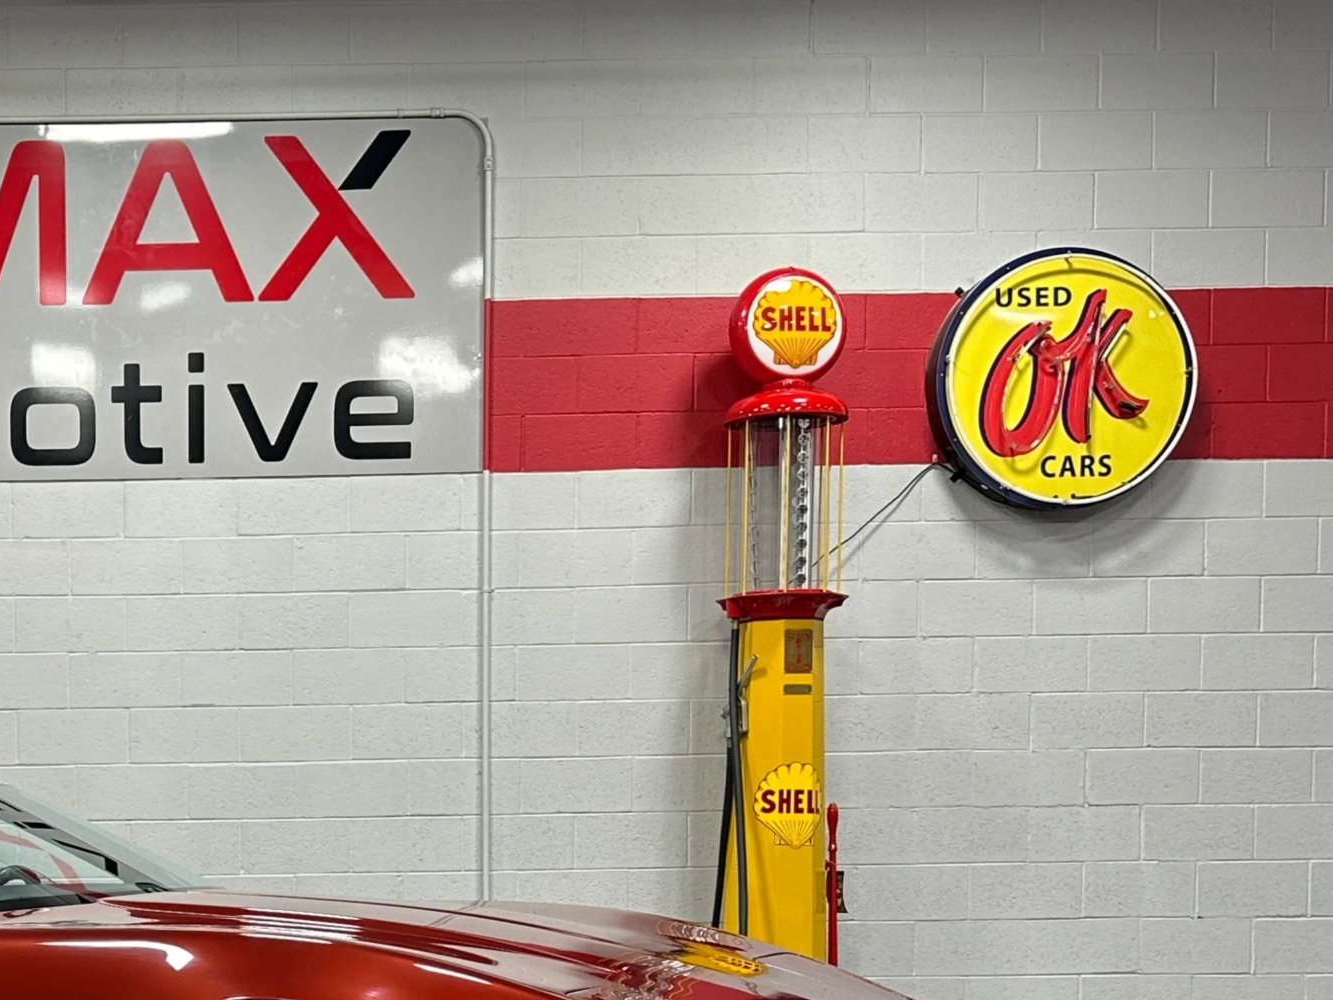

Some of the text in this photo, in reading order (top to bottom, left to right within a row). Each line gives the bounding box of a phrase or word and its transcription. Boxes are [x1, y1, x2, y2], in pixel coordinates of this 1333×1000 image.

[994, 286, 1073, 308] USED
[761, 305, 833, 333] SHELL
[978, 288, 1150, 458] OK
[1040, 454, 1112, 478] CARS
